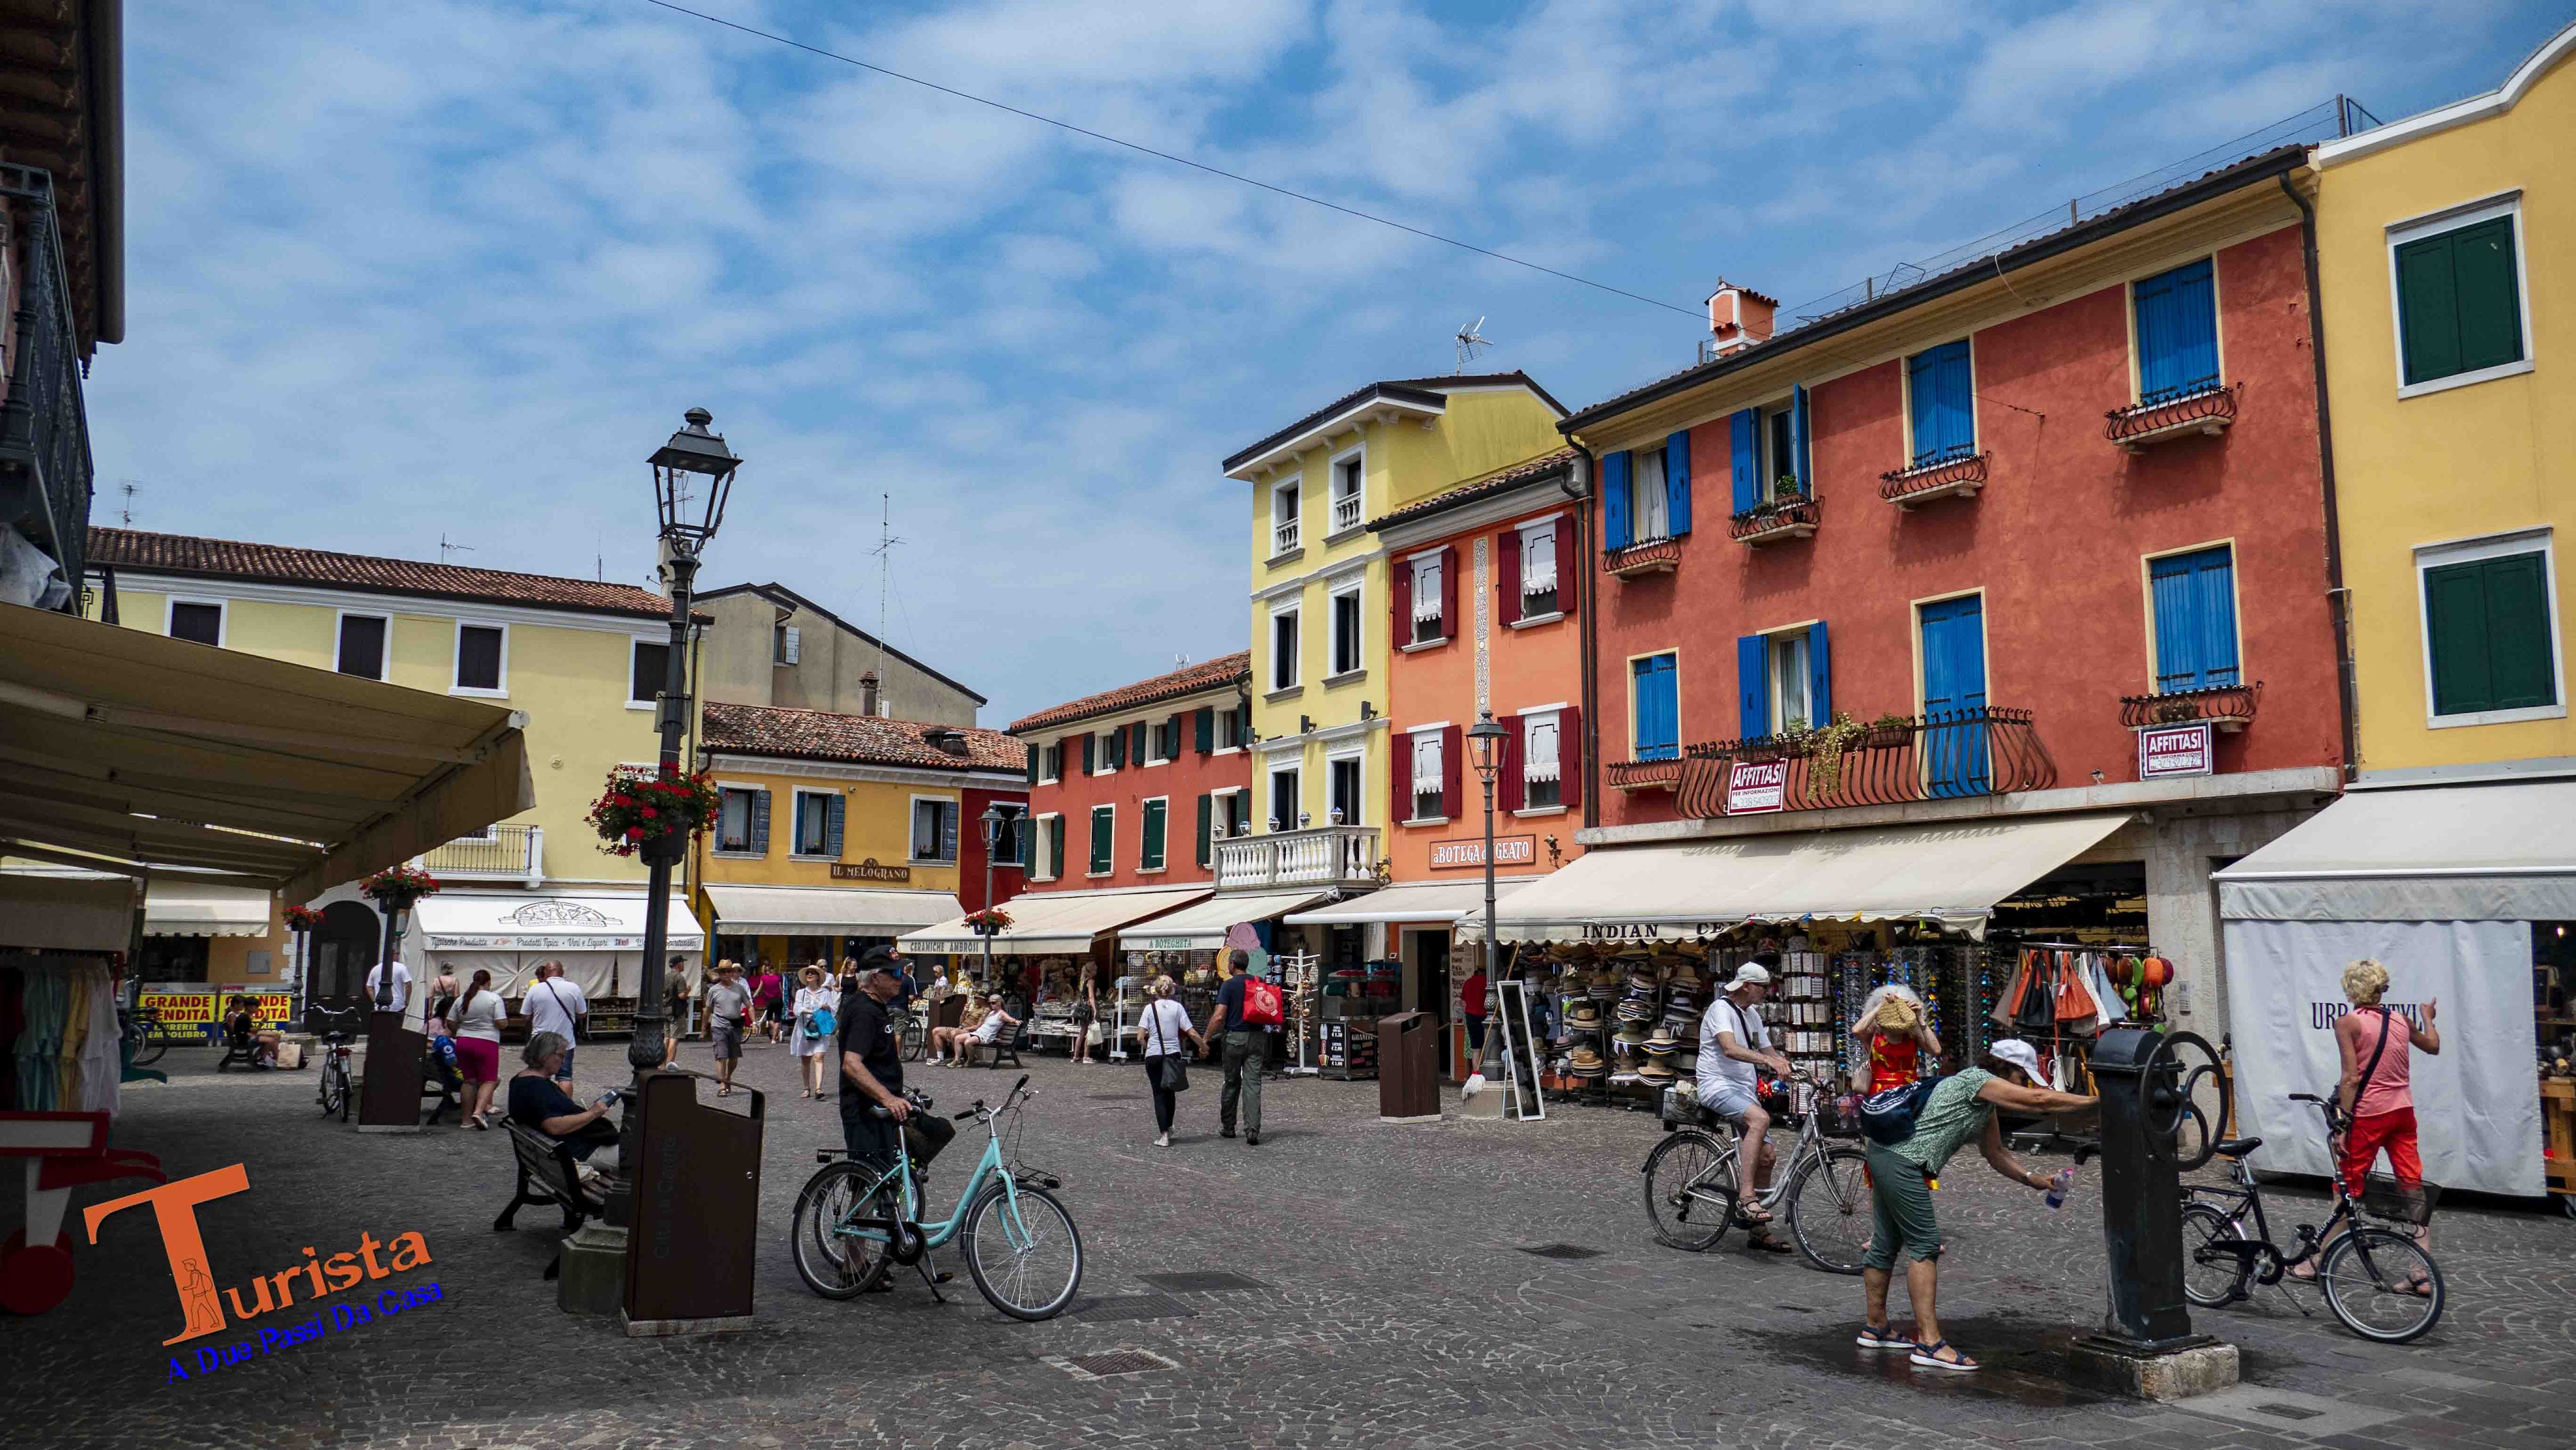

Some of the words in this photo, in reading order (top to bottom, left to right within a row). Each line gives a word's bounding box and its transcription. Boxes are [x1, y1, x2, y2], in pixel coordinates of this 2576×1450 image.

[2149, 732, 2201, 752] AFFITTASI
[1733, 763, 1784, 788] AFFITTASI
[1496, 841, 1529, 861] GEATO
[833, 866, 843, 876] IL
[847, 867, 908, 879] MELOGRANO
[1582, 924, 1658, 938] INDIAN
[459, 937, 487, 946] Produkte
[516, 937, 541, 946] Prodotti
[543, 937, 559, 949] Tipici
[568, 938, 580, 946] Vini
[587, 938, 608, 949] Liquori
[910, 942, 945, 952] CERAMICHE
[949, 942, 979, 952] AMBROSI
[145, 996, 210, 1008] GRANDE
[152, 1008, 211, 1020] ENDITA
